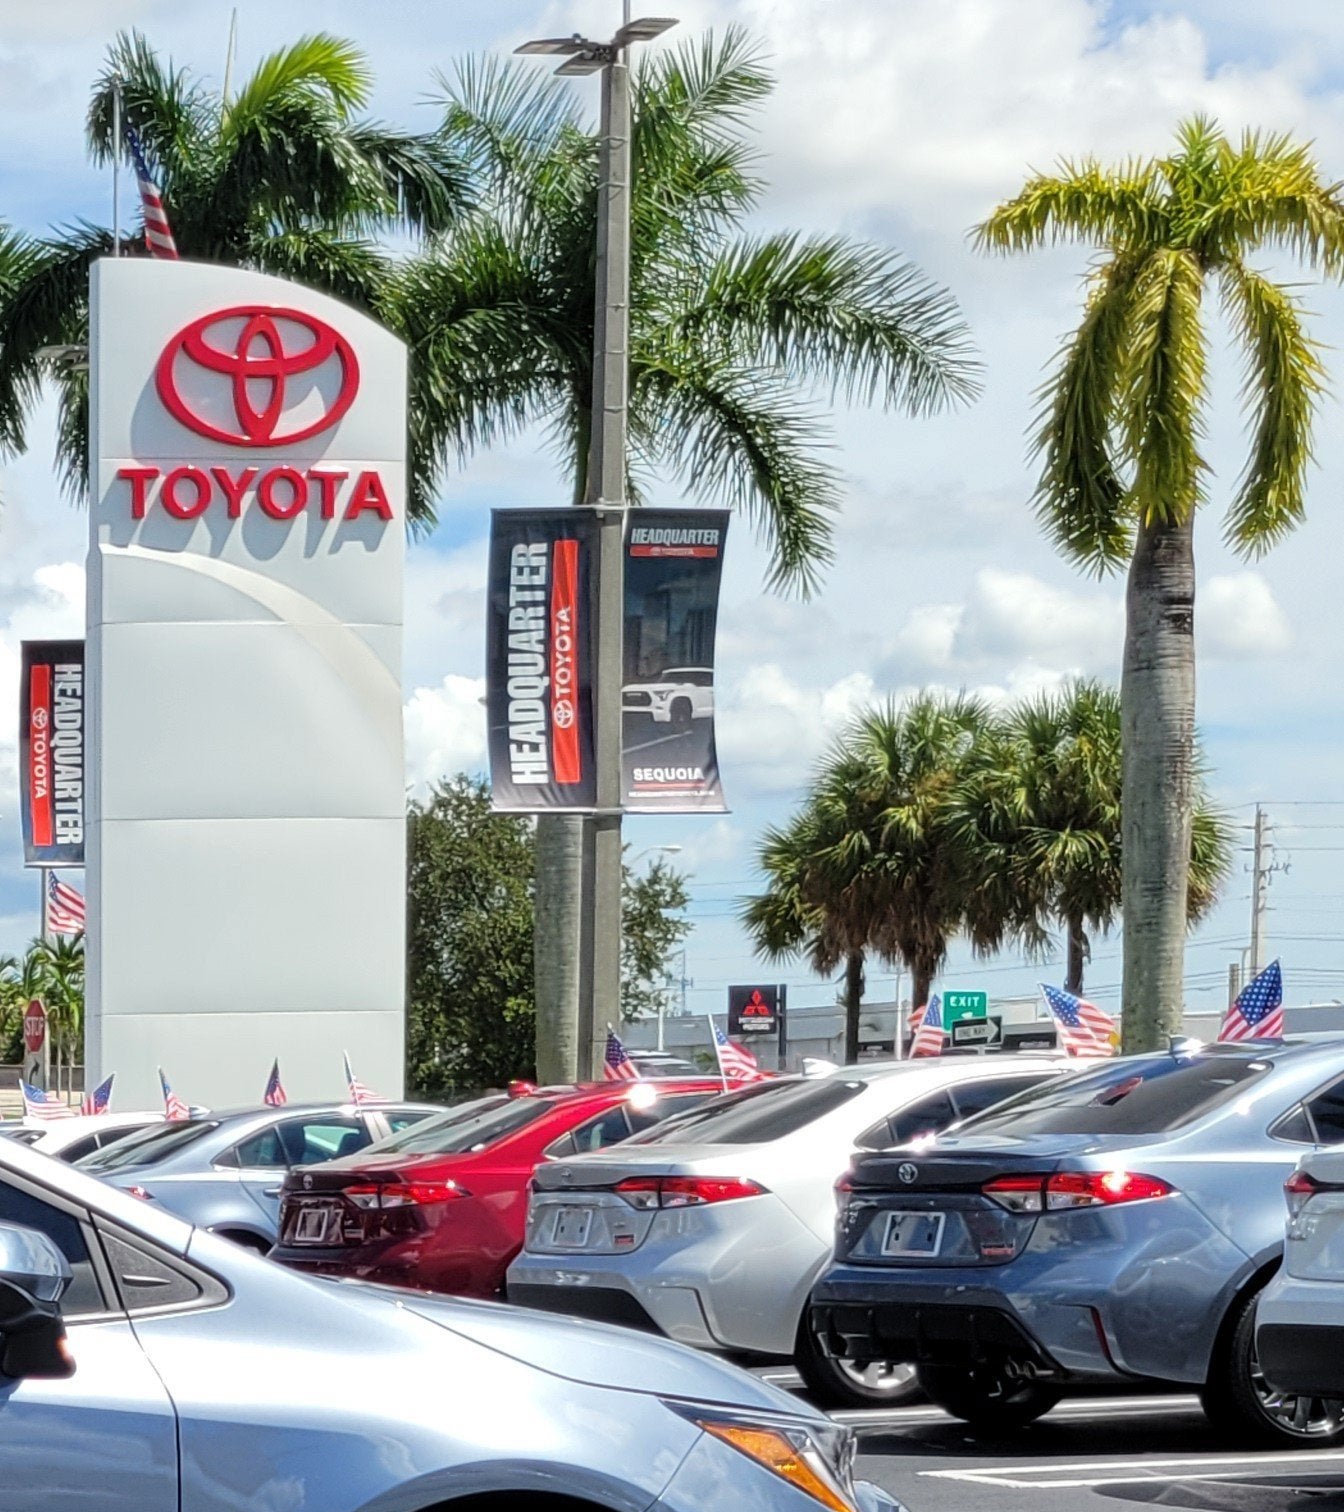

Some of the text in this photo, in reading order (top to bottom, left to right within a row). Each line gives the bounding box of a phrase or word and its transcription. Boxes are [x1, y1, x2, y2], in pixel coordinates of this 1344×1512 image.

[117, 466, 393, 520] TOYOTA
[631, 529, 719, 546] HEADQUARTER
[507, 542, 549, 785] HEADQUARTER
[555, 606, 572, 698] TOYOTA
[33, 733, 47, 799] TOYOTA
[54, 663, 83, 846] HEADQUARTER
[633, 767, 705, 784] SEQUOIA
[25, 1017, 45, 1036] STOP
[950, 996, 979, 1007] EXIT
